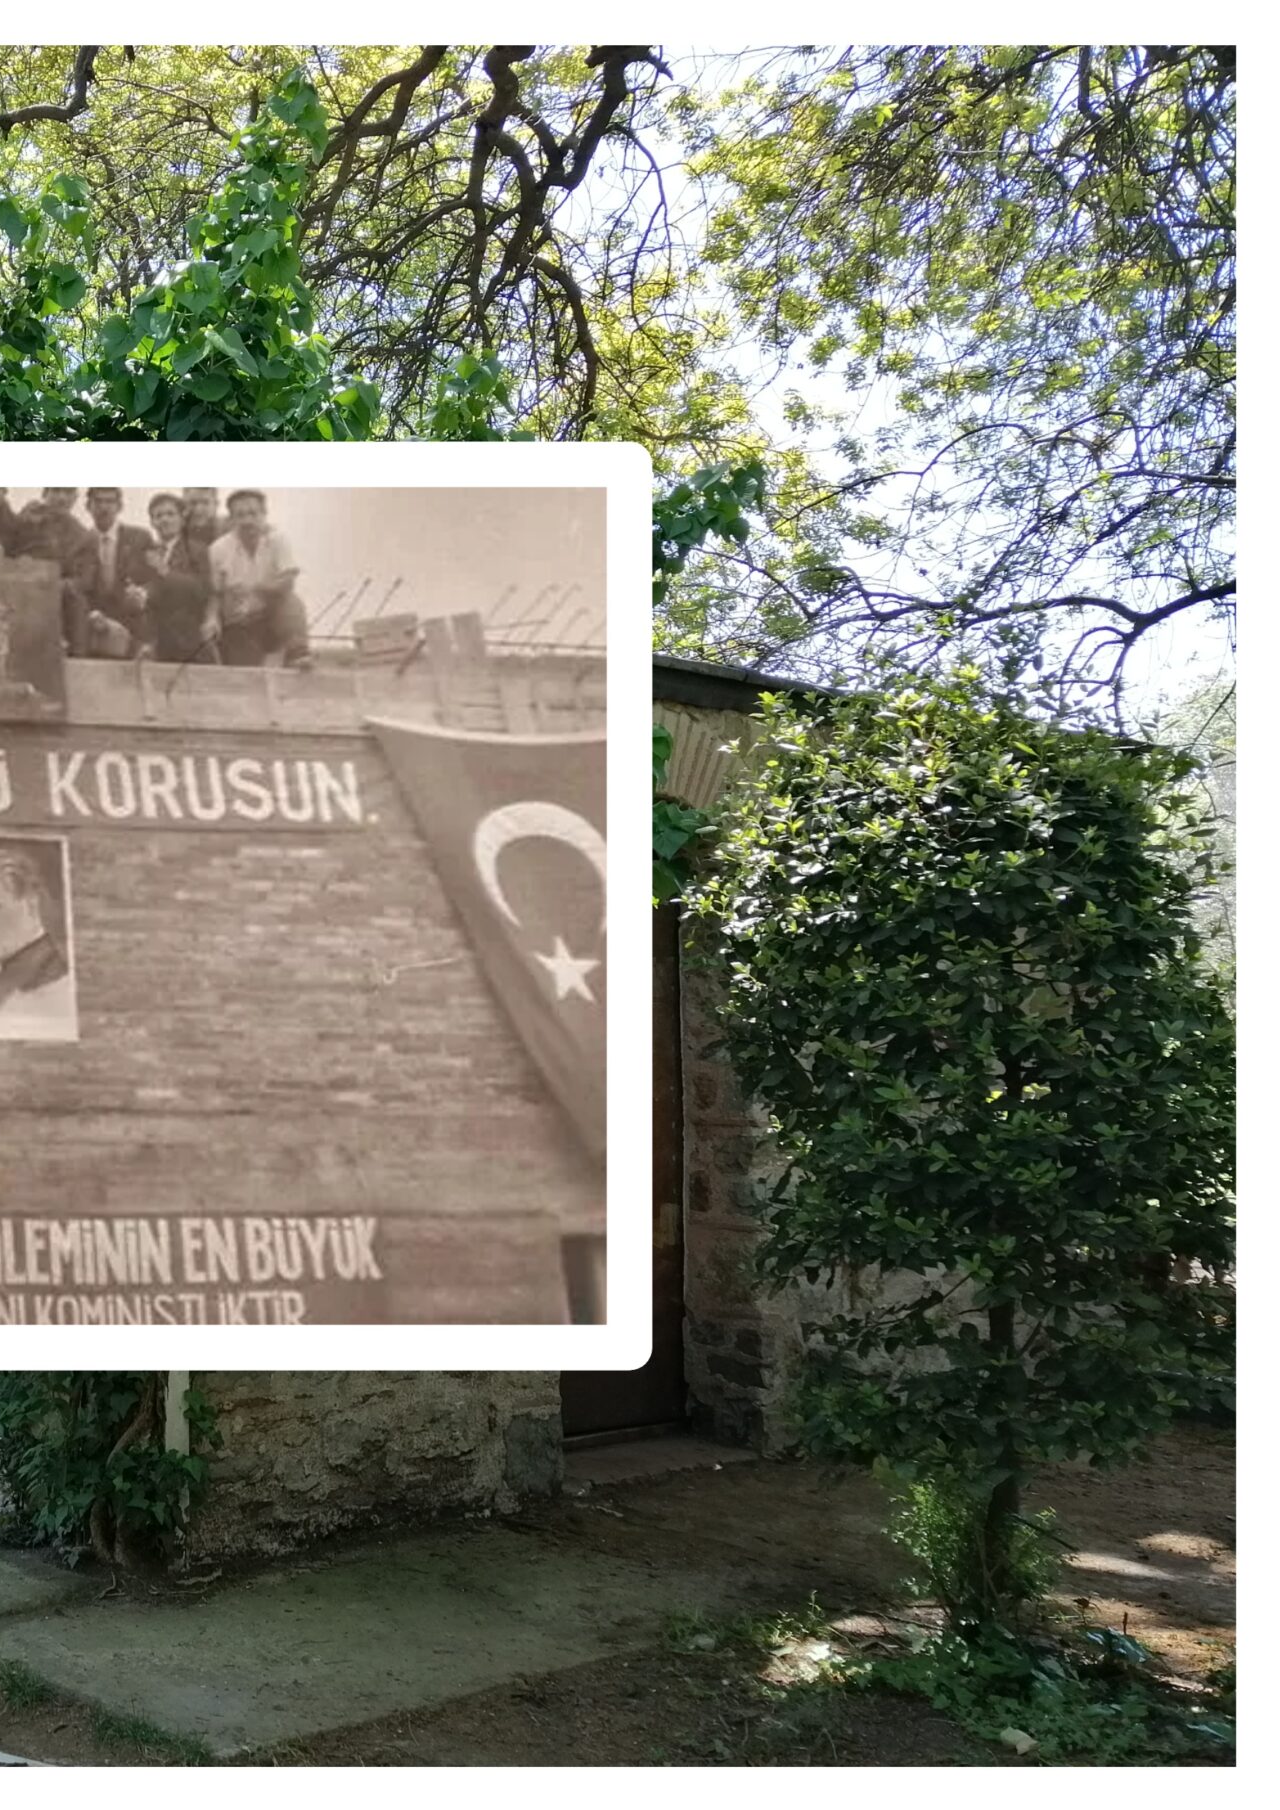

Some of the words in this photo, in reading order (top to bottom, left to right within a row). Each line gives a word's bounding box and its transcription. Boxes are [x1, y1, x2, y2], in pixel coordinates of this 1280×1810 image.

[46, 751, 380, 824] KORUSUN.
[180, 1217, 240, 1284] EN
[243, 1216, 383, 1281] BÜYÜK
